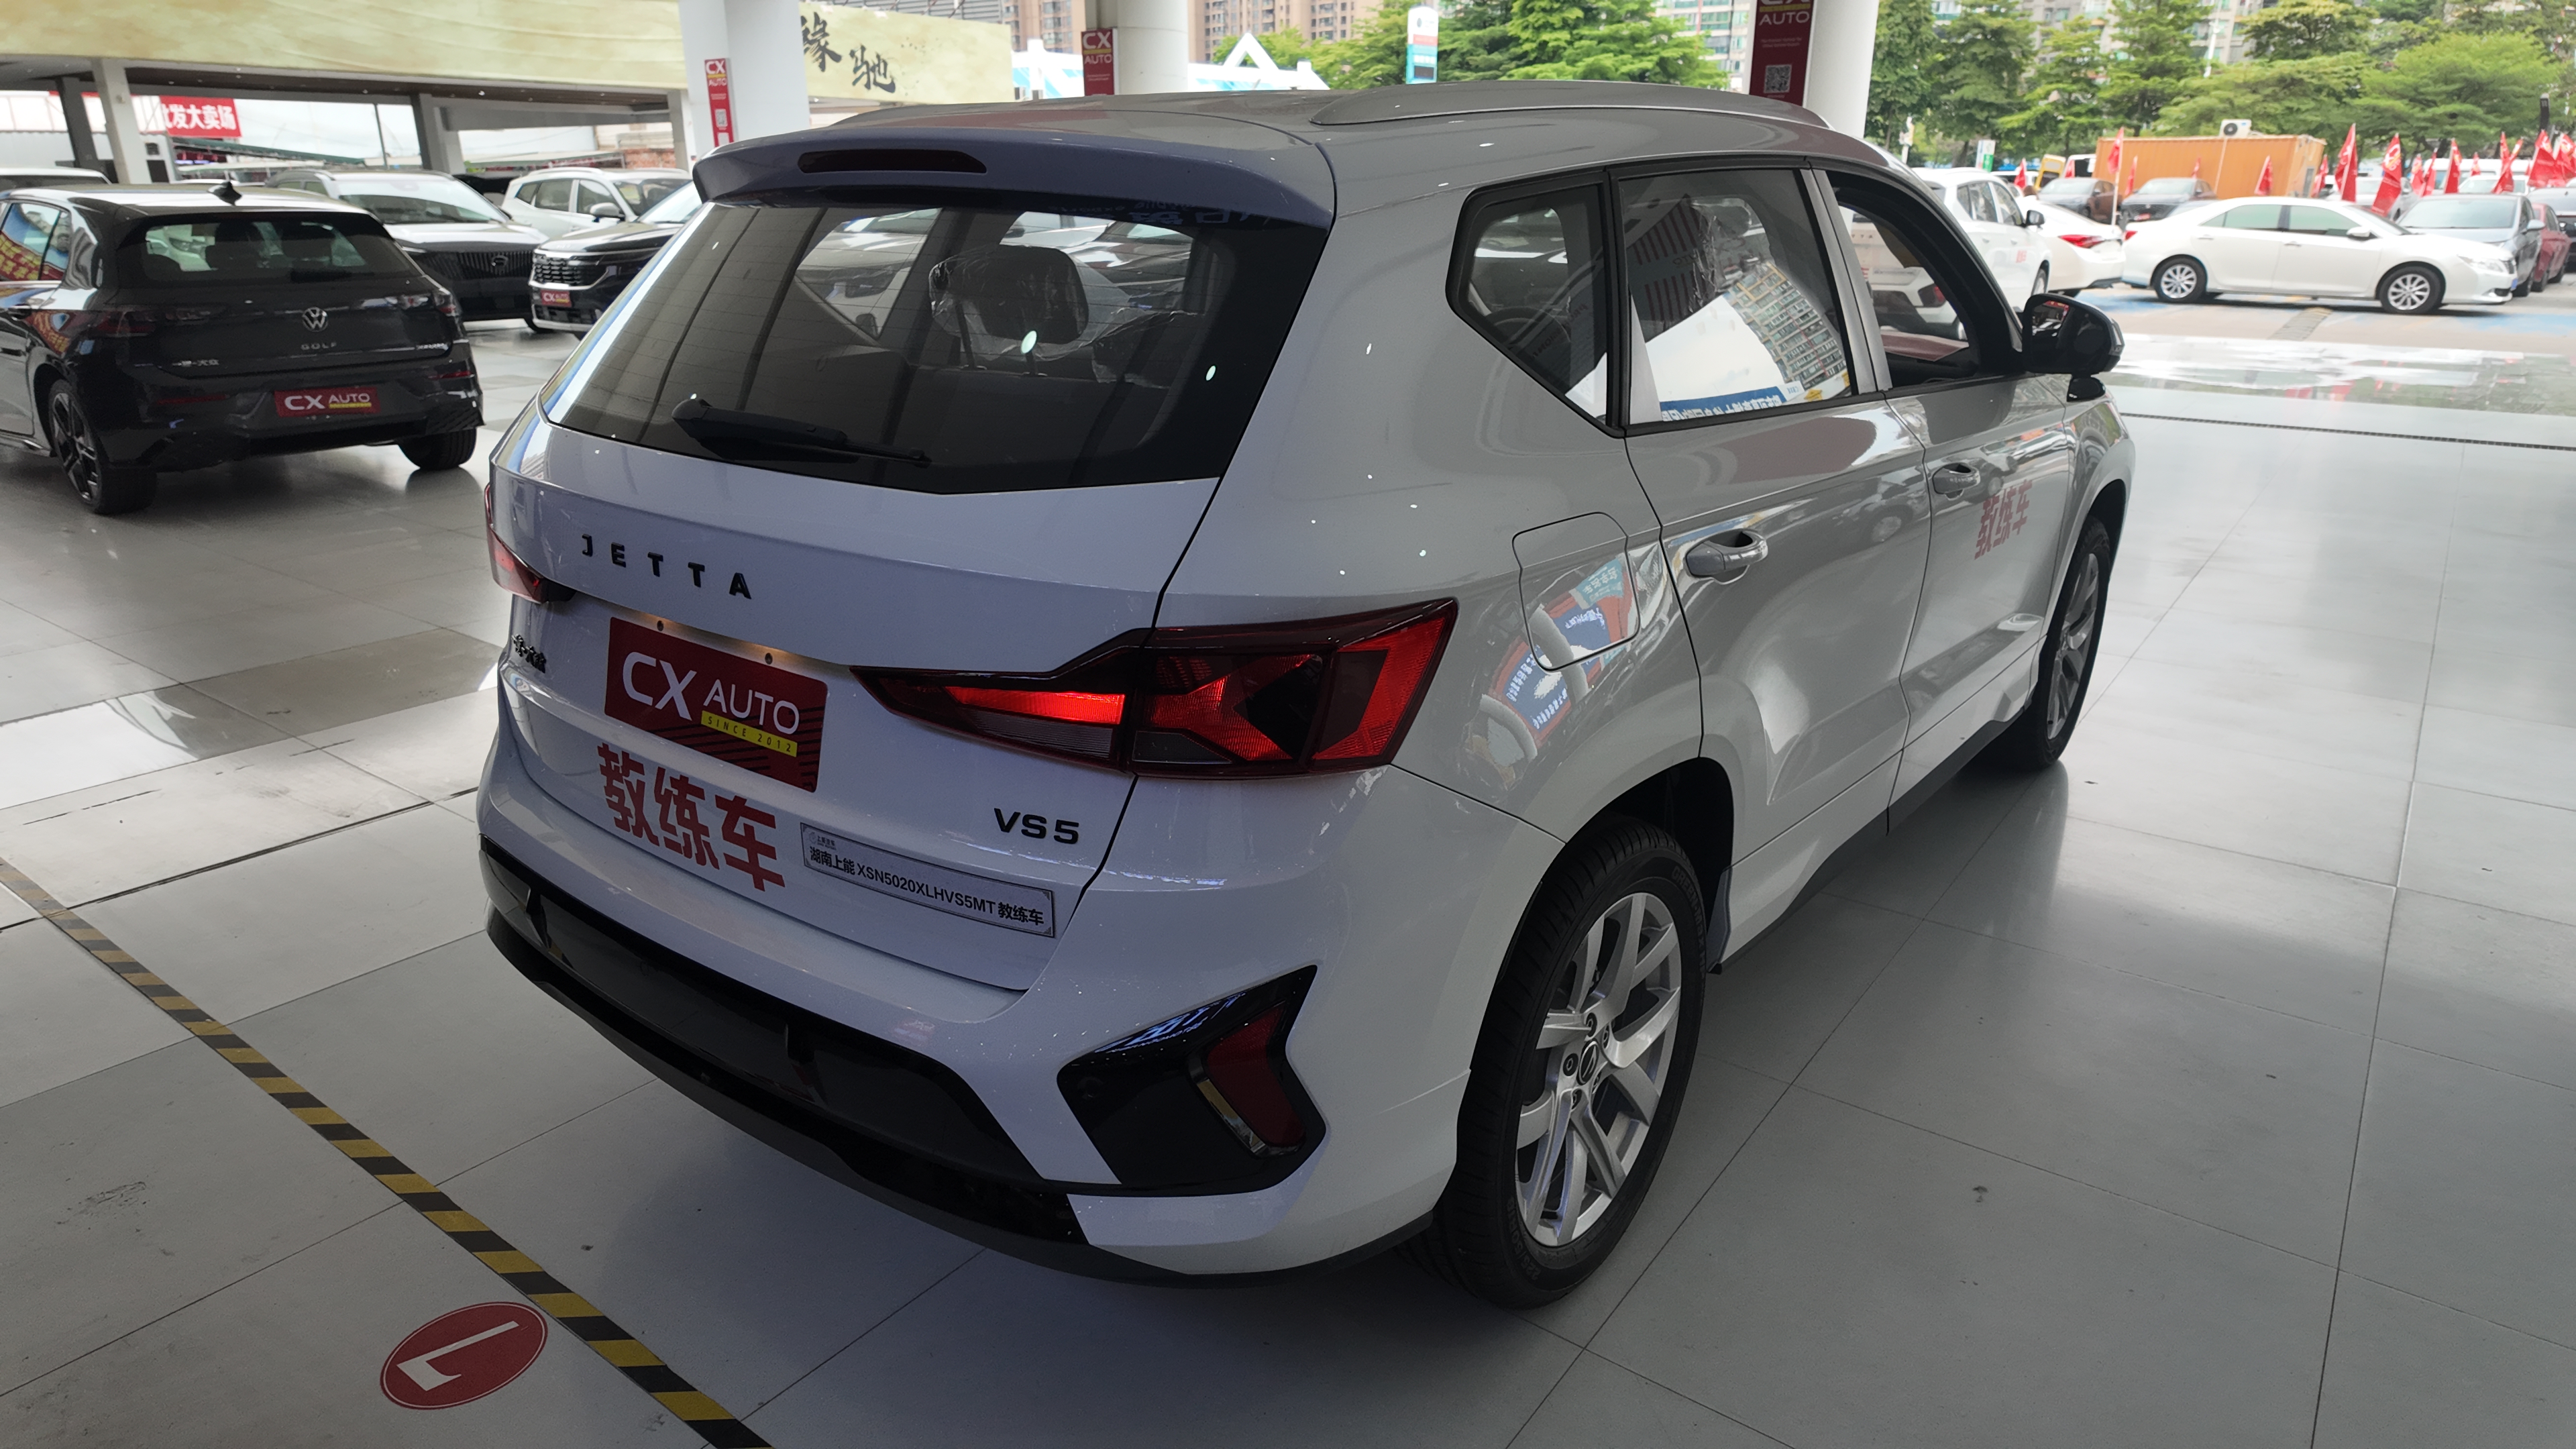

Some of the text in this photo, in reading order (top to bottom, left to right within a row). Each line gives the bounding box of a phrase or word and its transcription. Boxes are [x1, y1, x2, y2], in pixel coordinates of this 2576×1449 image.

[1758, 11, 1810, 25] AUTO
[1083, 31, 1112, 49] CX
[706, 60, 726, 74] CX
[1084, 54, 1112, 64] AUTO
[708, 77, 727, 87] AUTO
[543, 292, 555, 302] CX
[301, 342, 337, 350] GOLF
[284, 394, 326, 410] CX
[329, 392, 370, 403] AUTO
[1974, 479, 2033, 559] 教练车
[582, 533, 752, 599] JETTA
[623, 651, 800, 735] CX AUTO
[707, 716, 792, 753] SINCE 2012
[597, 742, 786, 892] 教练车
[994, 808, 1079, 845] VS5
[809, 846, 1044, 926] 湖南上能 XSN5020XLHVS5MT 教练车
